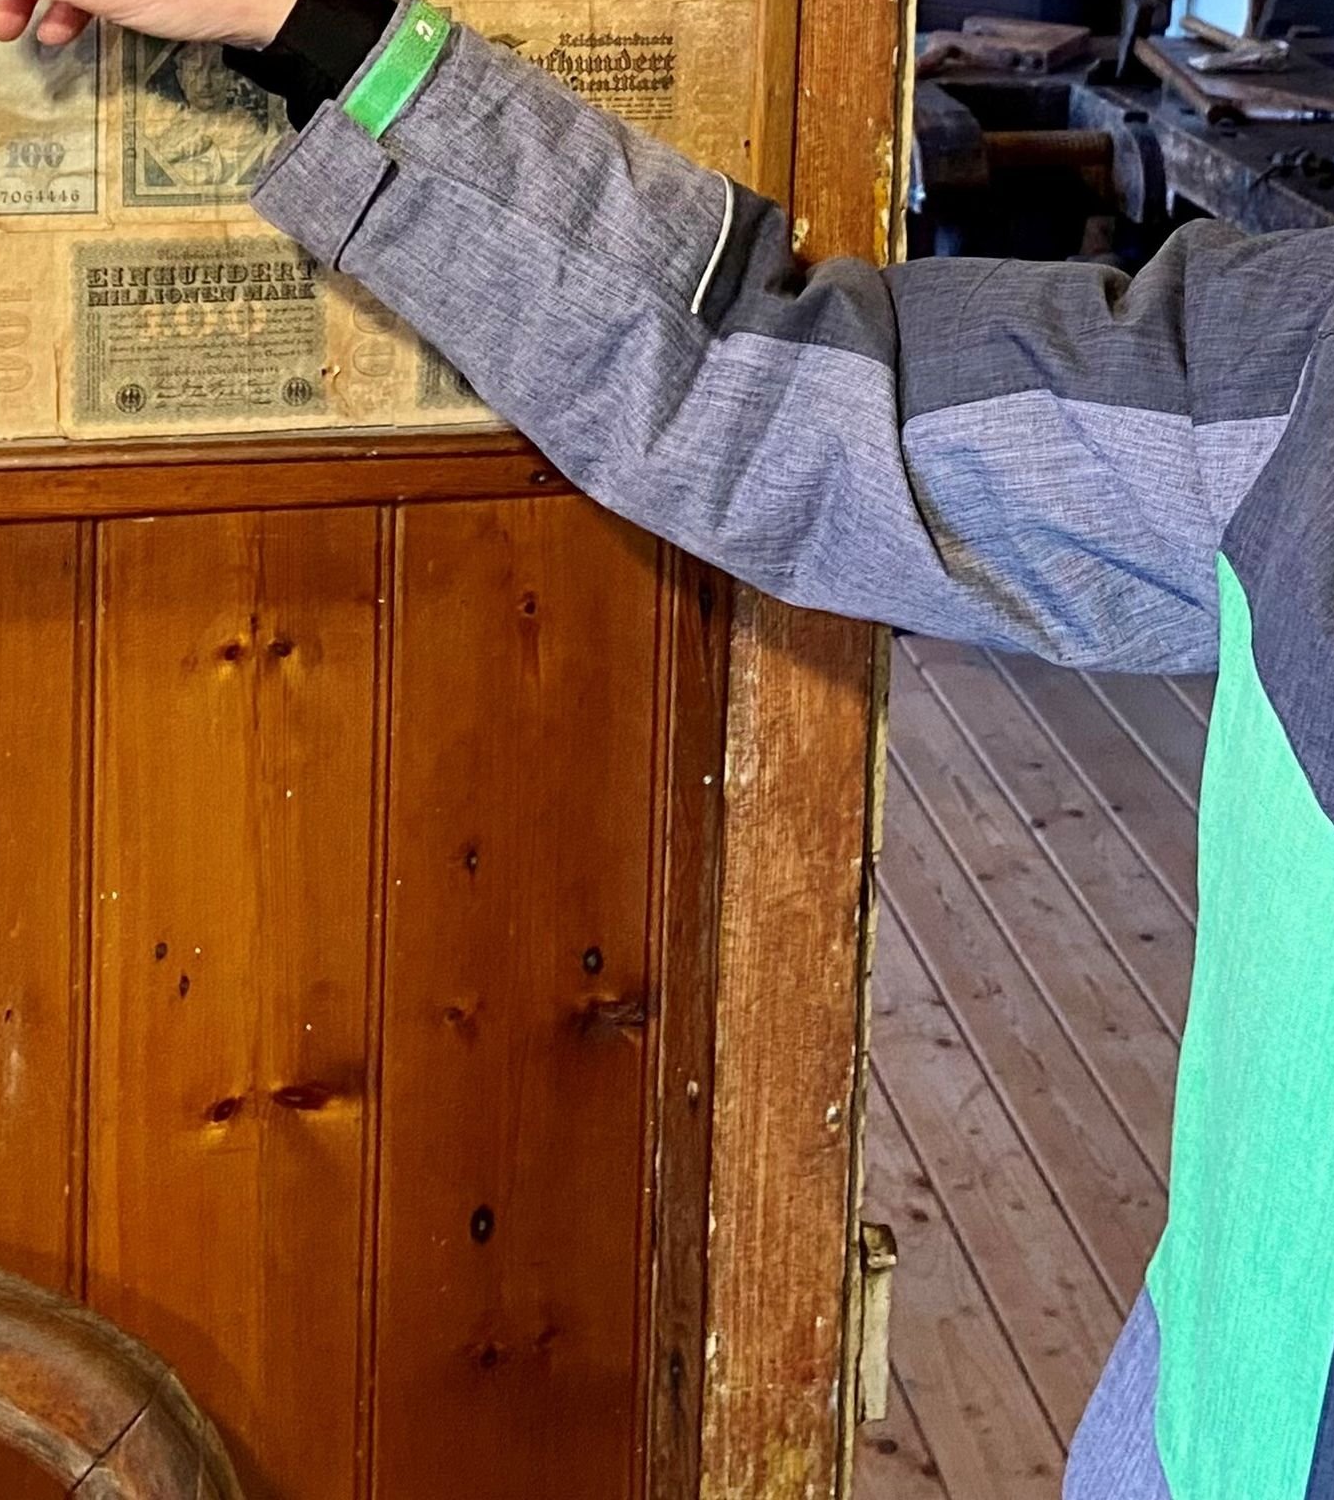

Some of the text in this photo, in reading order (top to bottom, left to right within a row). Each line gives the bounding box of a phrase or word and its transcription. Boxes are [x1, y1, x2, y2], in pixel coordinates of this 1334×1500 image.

[4, 142, 65, 168] 100
[87, 262, 318, 287] EINHUNDERT
[88, 283, 316, 307] MILLIONEN MARK
